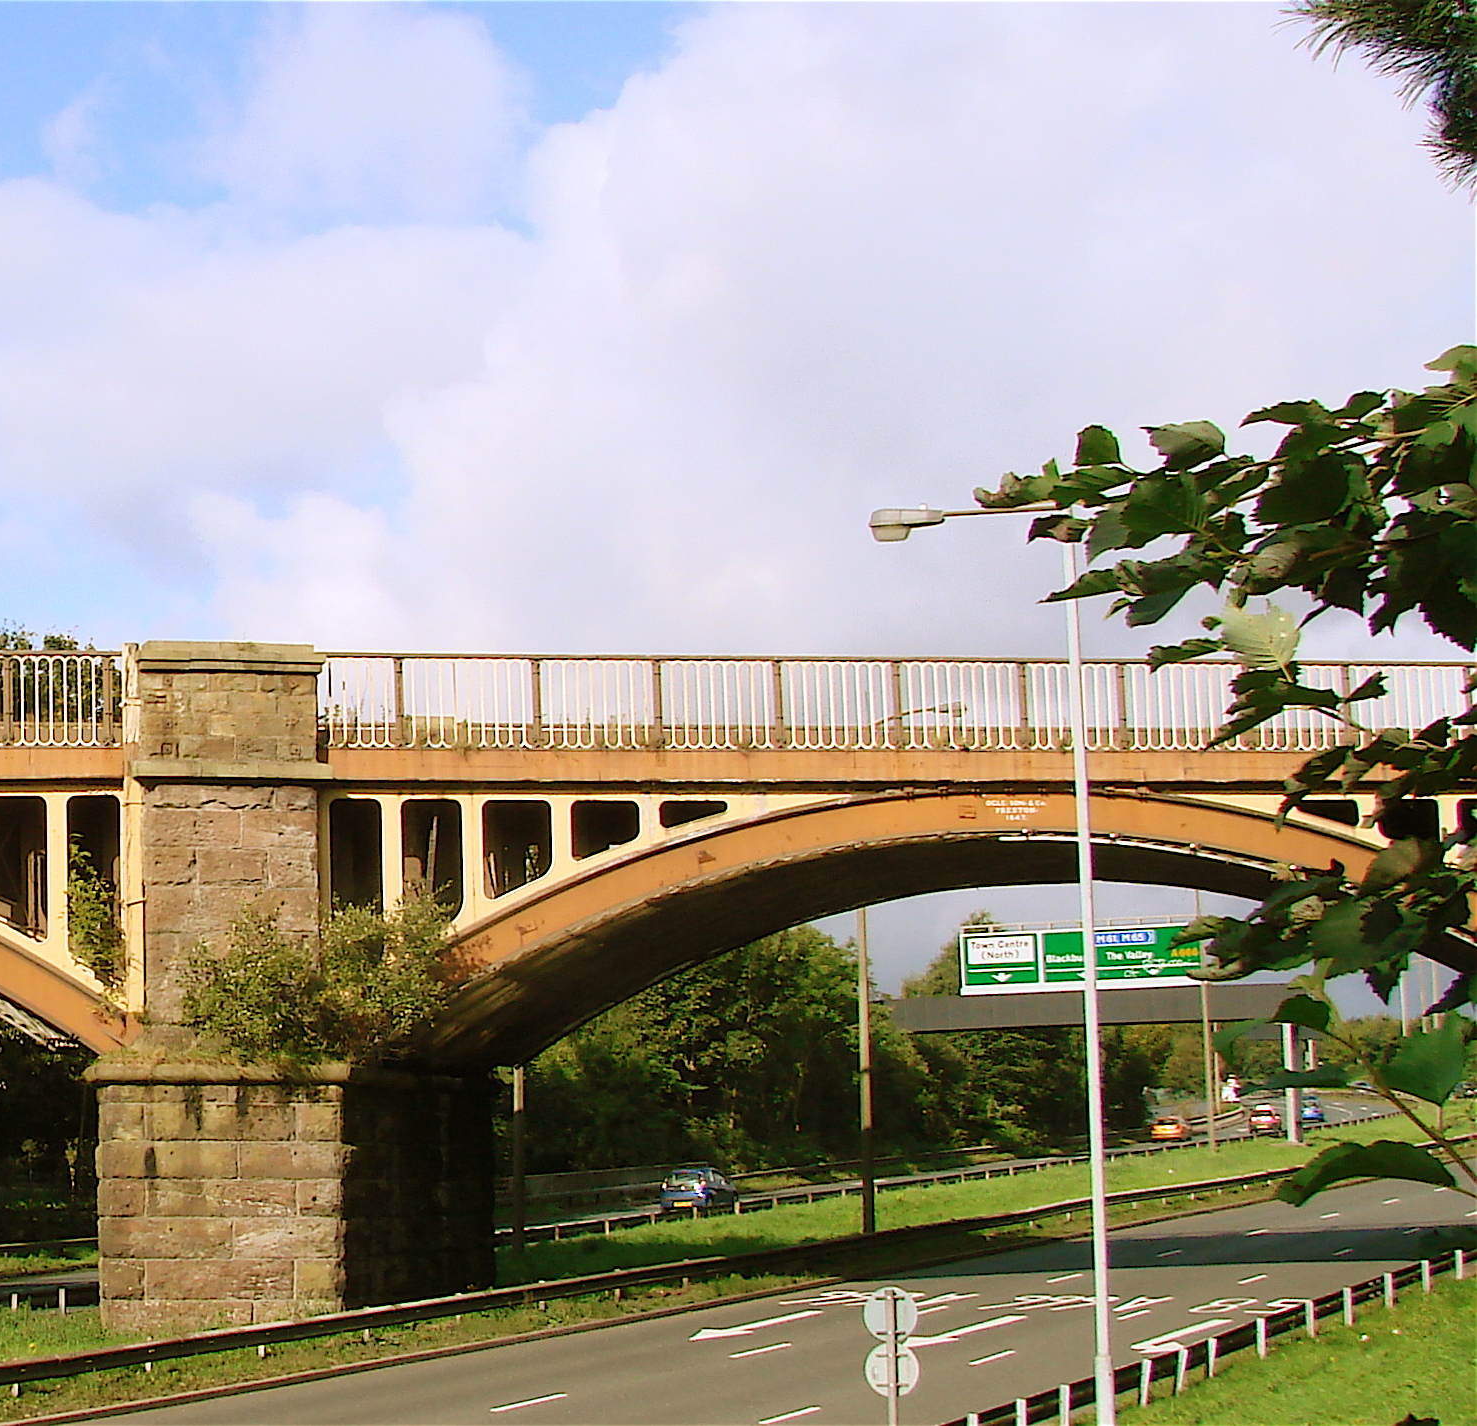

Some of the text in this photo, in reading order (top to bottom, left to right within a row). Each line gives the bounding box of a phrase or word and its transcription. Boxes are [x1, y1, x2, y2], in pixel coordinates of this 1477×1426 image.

[971, 940, 1029, 950] Town Centre
[981, 950, 1019, 960] (North)
[1045, 954, 1084, 963] Blackbu
[1105, 950, 1153, 960] The Valley
